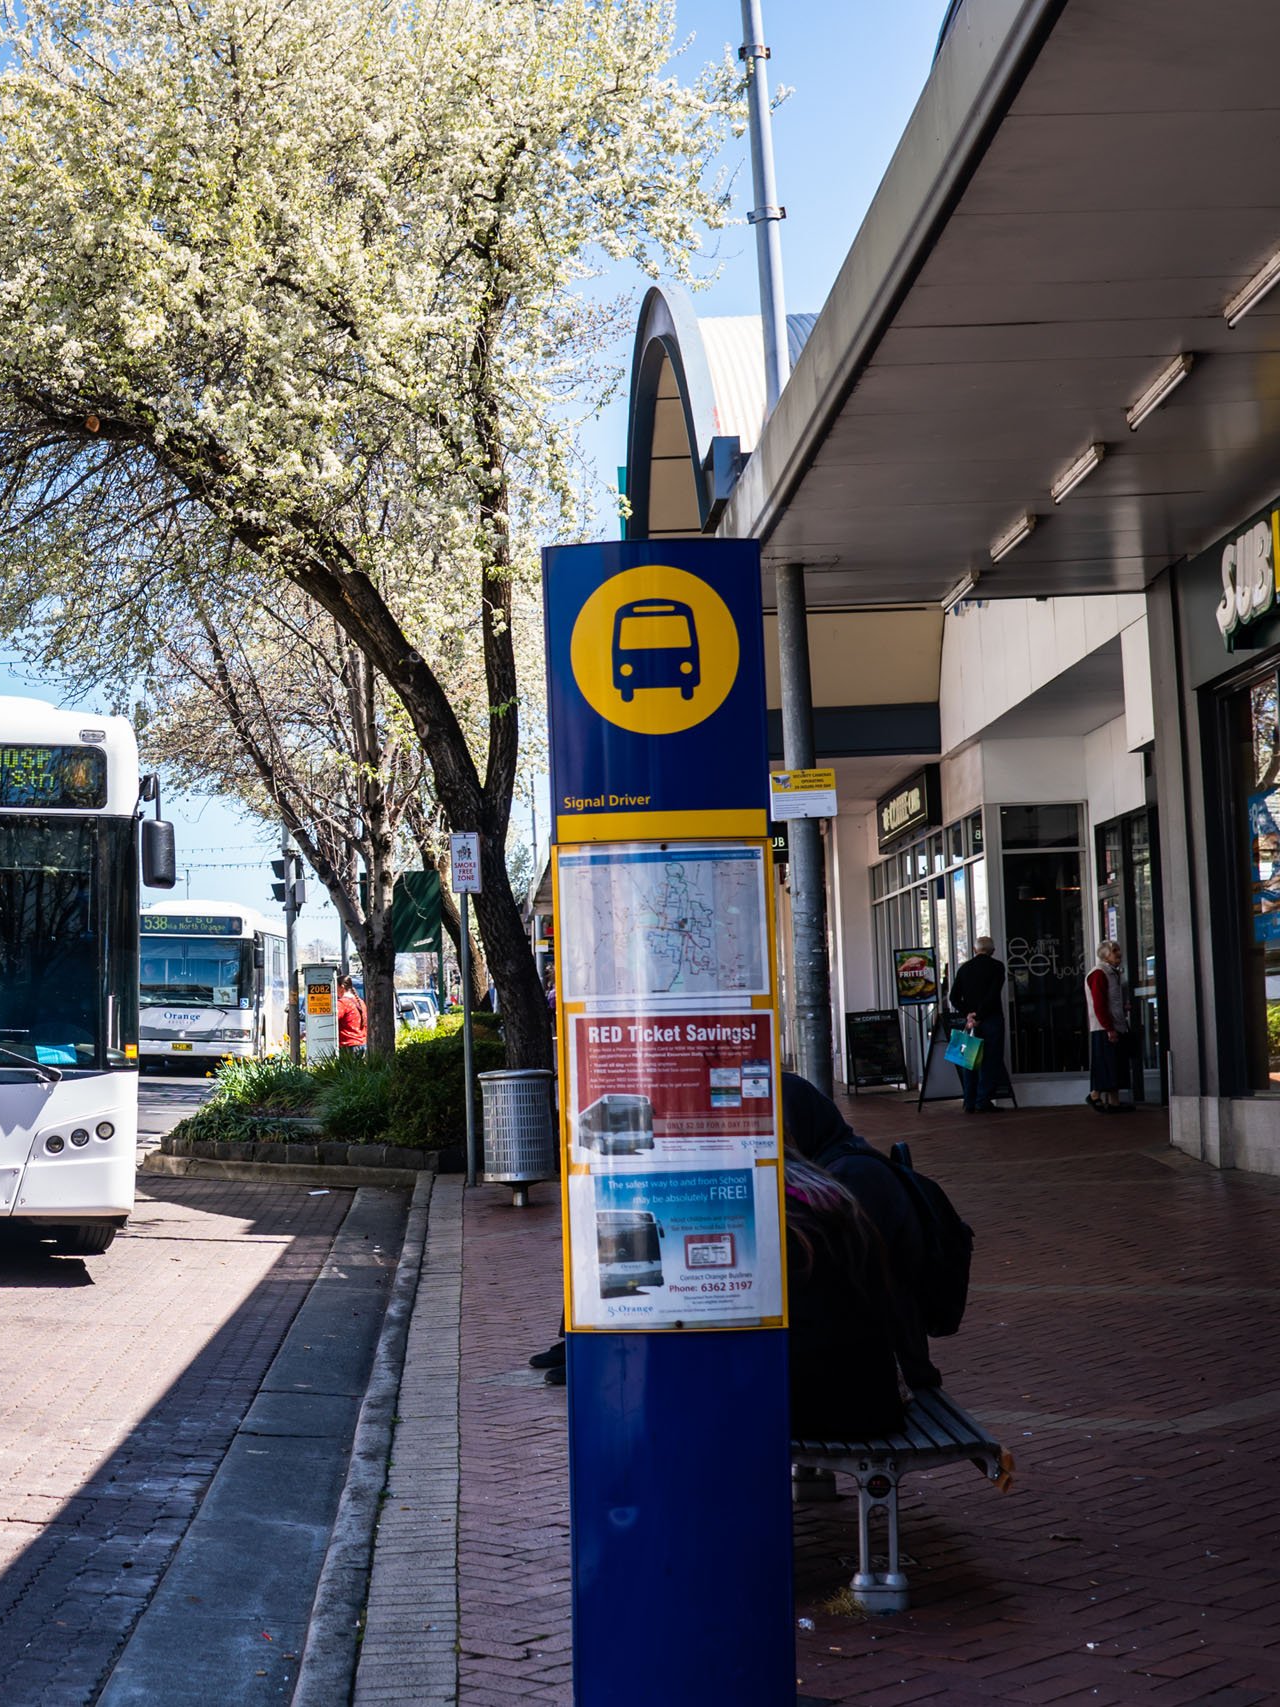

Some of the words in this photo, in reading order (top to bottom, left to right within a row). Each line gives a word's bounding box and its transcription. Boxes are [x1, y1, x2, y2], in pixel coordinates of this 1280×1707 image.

[1216, 508, 1280, 638] SUB
[564, 795, 605, 811] Signal
[609, 793, 651, 807] Driver
[144, 916, 167, 930] 538
[178, 922, 198, 930] North
[310, 984, 330, 993] 2082
[164, 1011, 201, 1022] Orange
[588, 1026, 622, 1043] RED
[627, 1025, 680, 1043] Ticket
[686, 1023, 756, 1045] Savings!
[608, 1180, 623, 1189] The
[651, 1180, 667, 1188] way
[680, 1178, 696, 1186] and
[719, 1175, 747, 1185] School
[653, 1195, 663, 1203] be
[665, 1192, 708, 1203] absolutely
[710, 1185, 747, 1200] FREE!
[705, 1272, 727, 1280] Orange
[669, 1284, 698, 1292] Phone:
[701, 1282, 726, 1292] 6362
[729, 1280, 753, 1291] 3197
